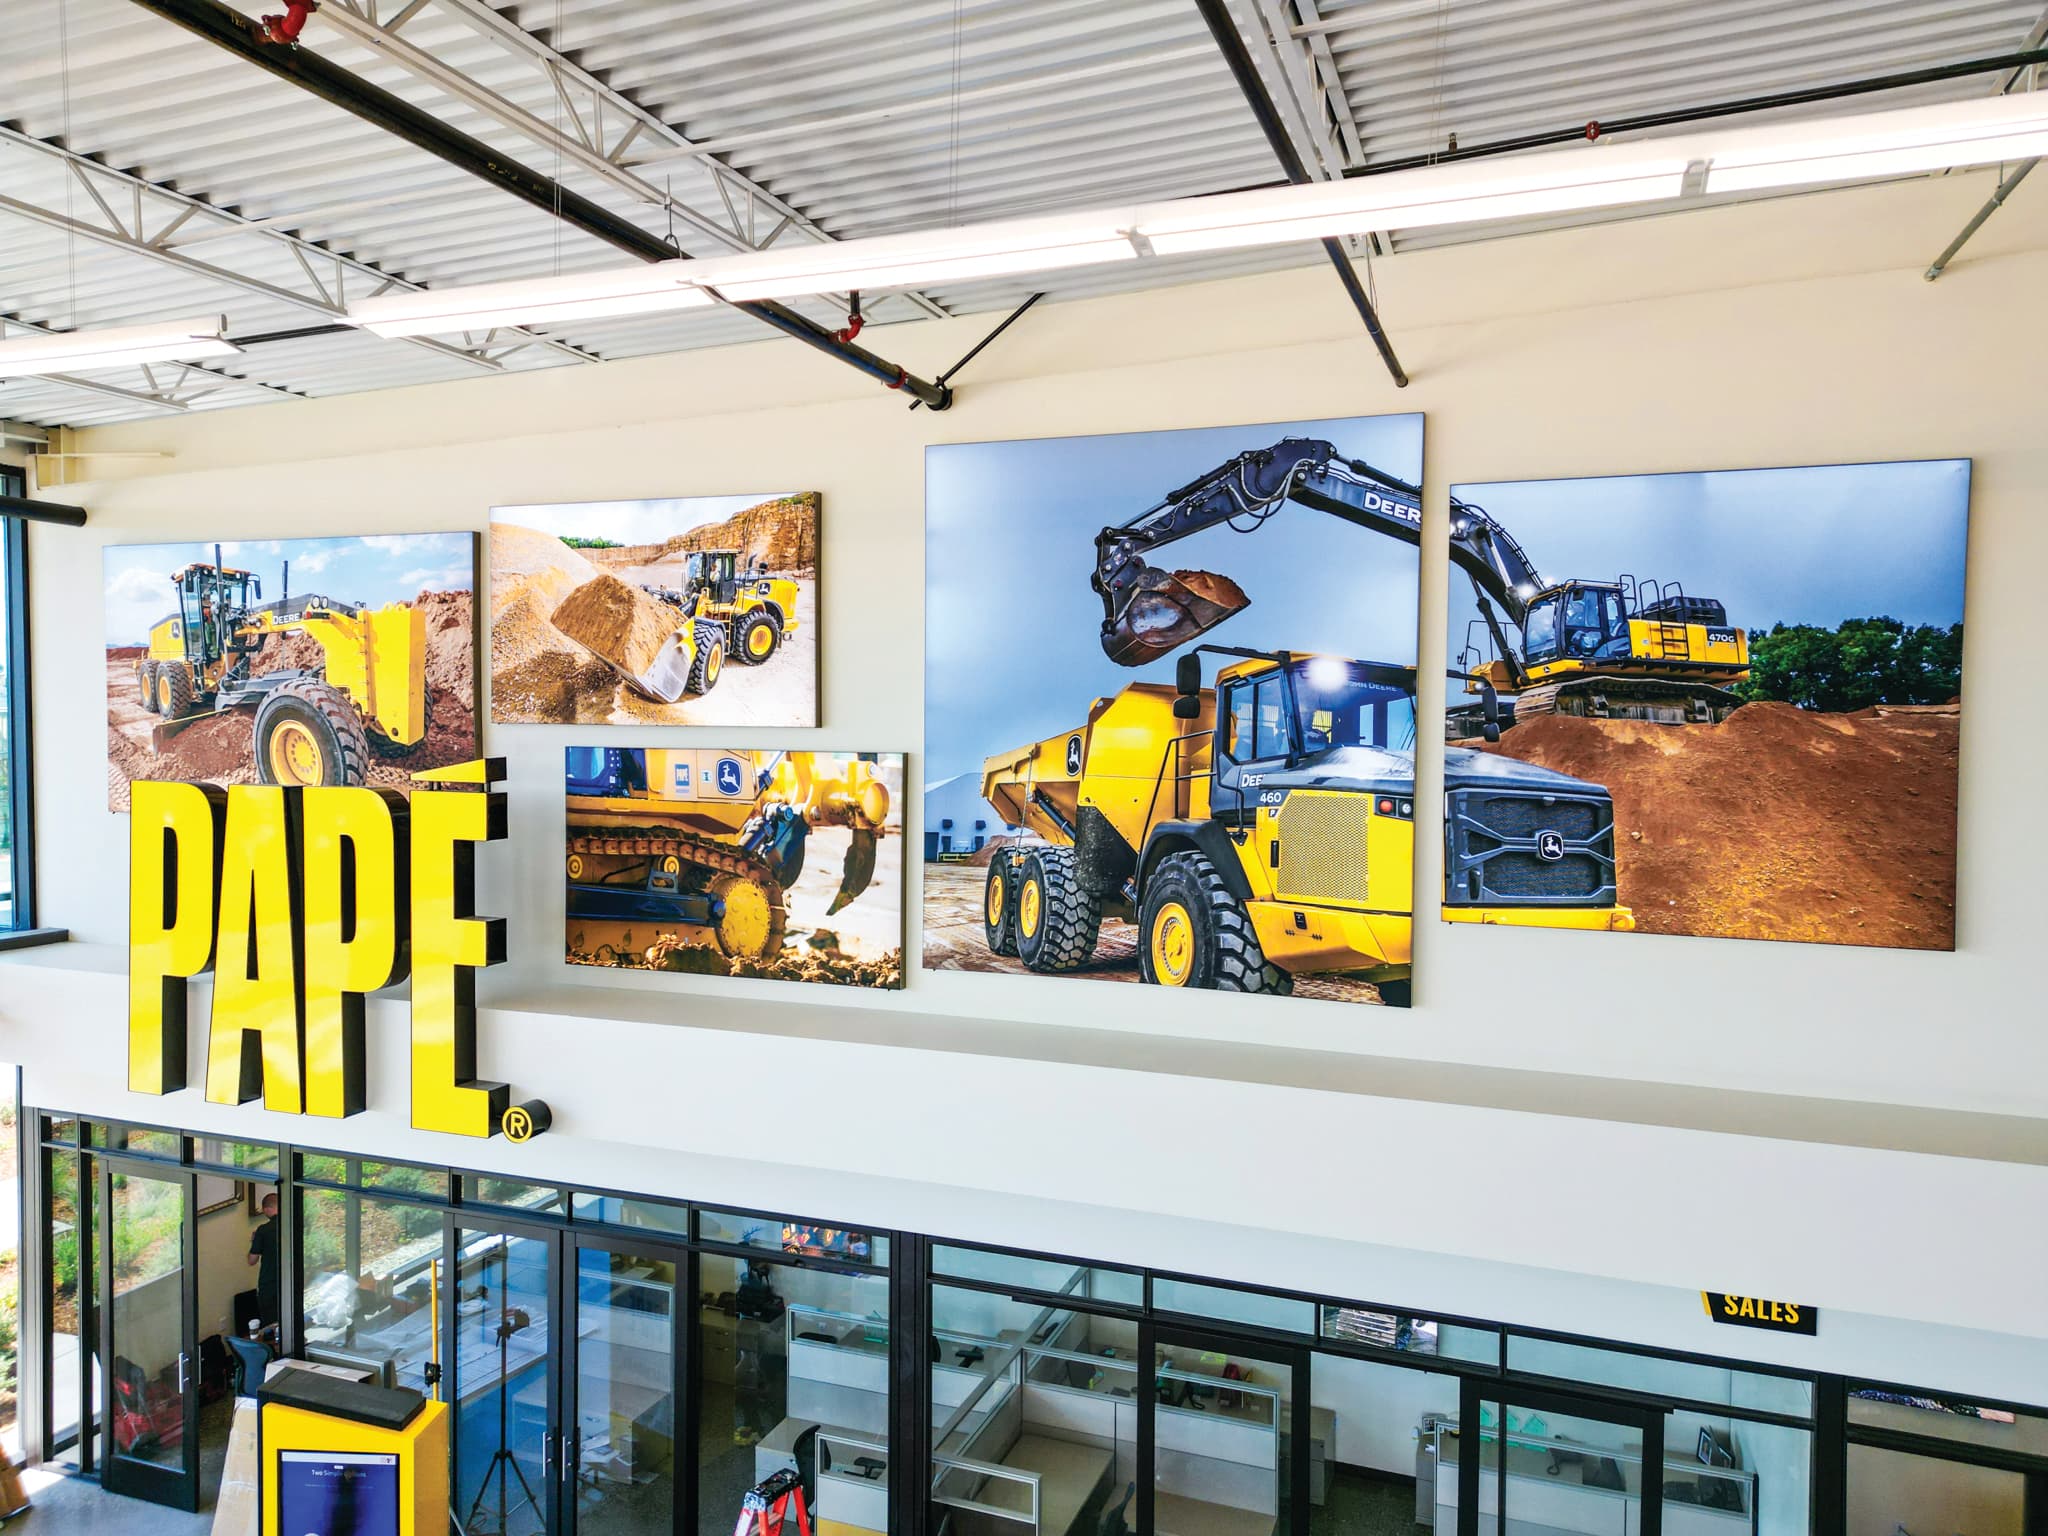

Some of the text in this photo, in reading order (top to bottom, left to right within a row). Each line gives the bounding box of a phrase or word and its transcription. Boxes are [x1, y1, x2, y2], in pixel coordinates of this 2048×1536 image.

[1364, 491, 1421, 524] DEER
[273, 612, 301, 625] DEERE
[1709, 633, 1735, 643] 470G
[1260, 792, 1282, 803] 460
[128, 758, 492, 1138] PAPÉ
[1723, 1294, 1800, 1325] SALES
